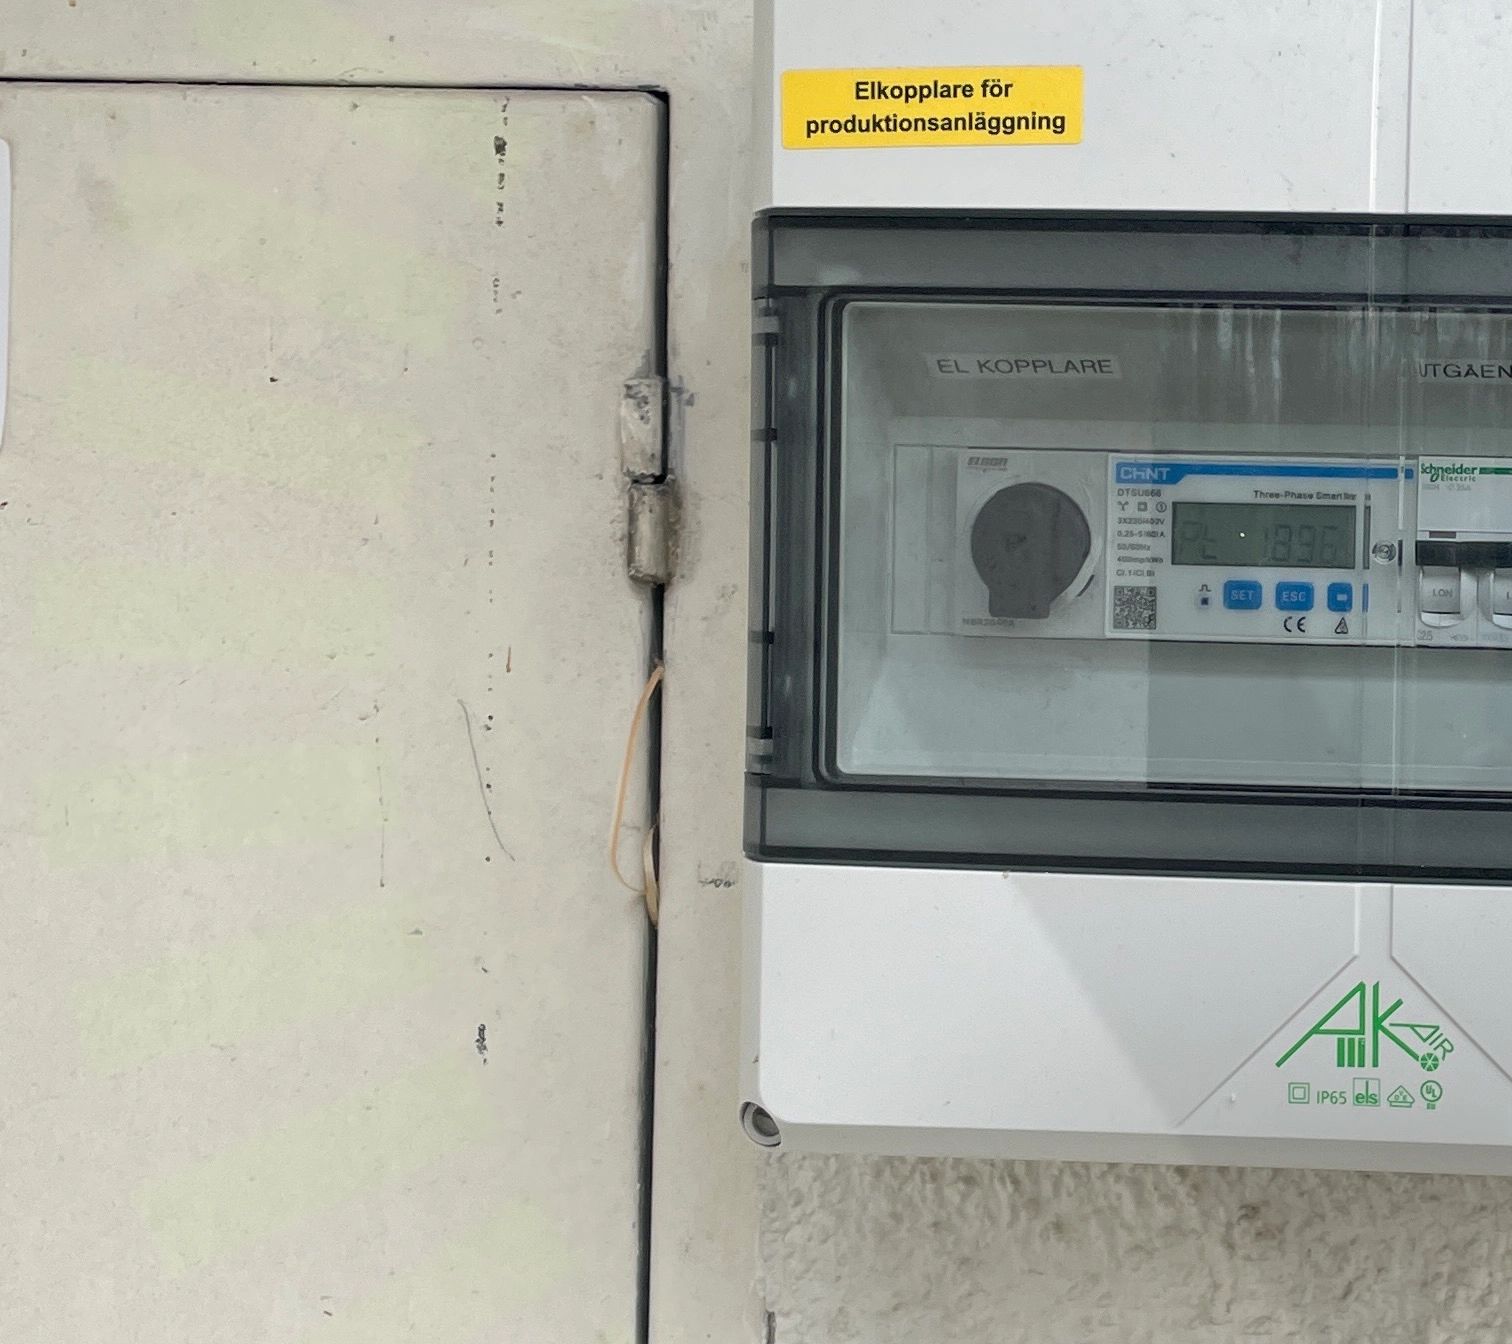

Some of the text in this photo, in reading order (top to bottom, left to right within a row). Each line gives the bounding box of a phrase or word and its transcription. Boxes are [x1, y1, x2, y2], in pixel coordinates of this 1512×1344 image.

[855, 79, 1014, 103] Elkopplare för
[806, 111, 1066, 138] produktionsanläggning
[937, 359, 1113, 374] EL KOPPLARE
[1420, 463, 1478, 482] Schneider
[1230, 589, 1254, 601] SET
[1282, 591, 1306, 602] ESC
[1316, 1091, 1347, 1105] IP65
